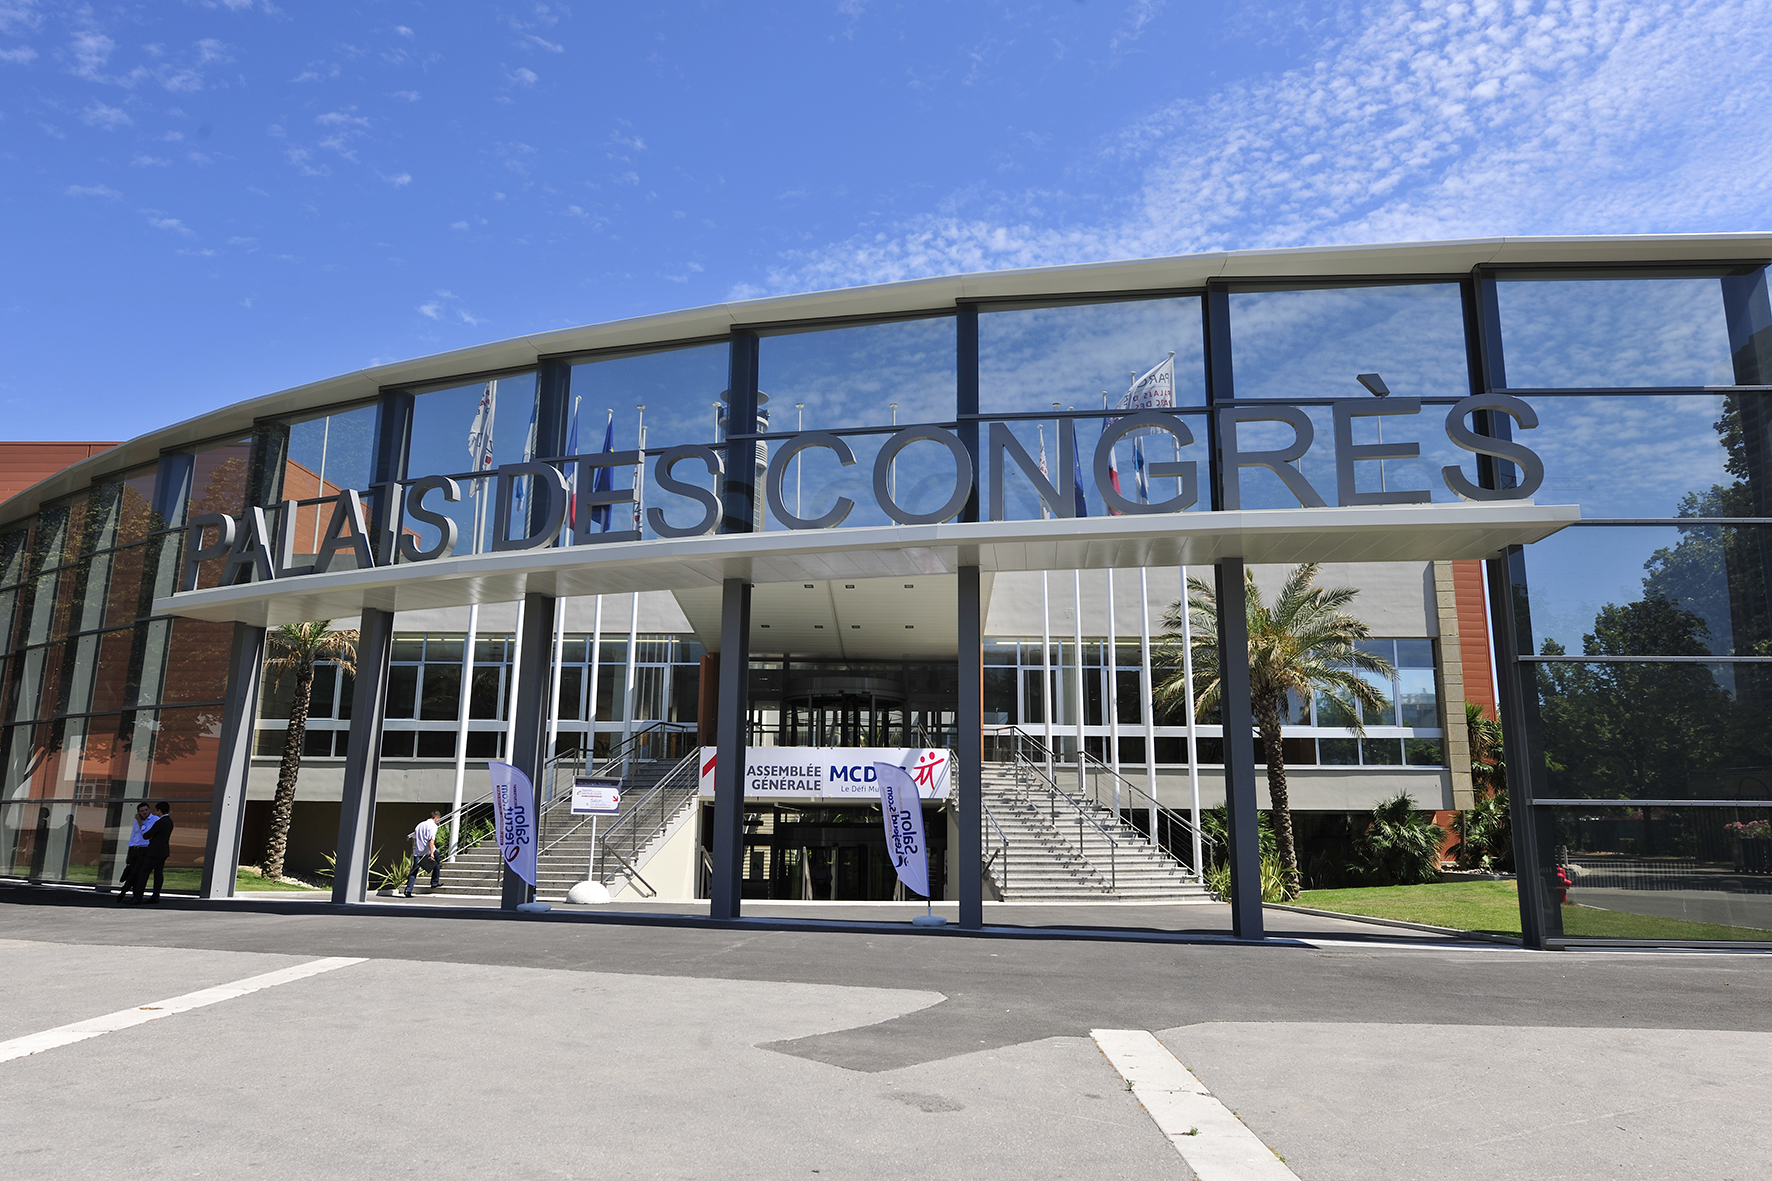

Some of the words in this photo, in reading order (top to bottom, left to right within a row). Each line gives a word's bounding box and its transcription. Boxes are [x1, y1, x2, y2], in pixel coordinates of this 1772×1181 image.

[181, 475, 461, 592] PALAIS
[491, 444, 725, 553] DES
[766, 372, 1545, 532] CONGRÈS
[746, 763, 822, 777] ASSEMBLÉE
[751, 776, 822, 791] GÉNÉRALE
[840, 785, 850, 793] Le
[851, 785, 867, 793] Défi
